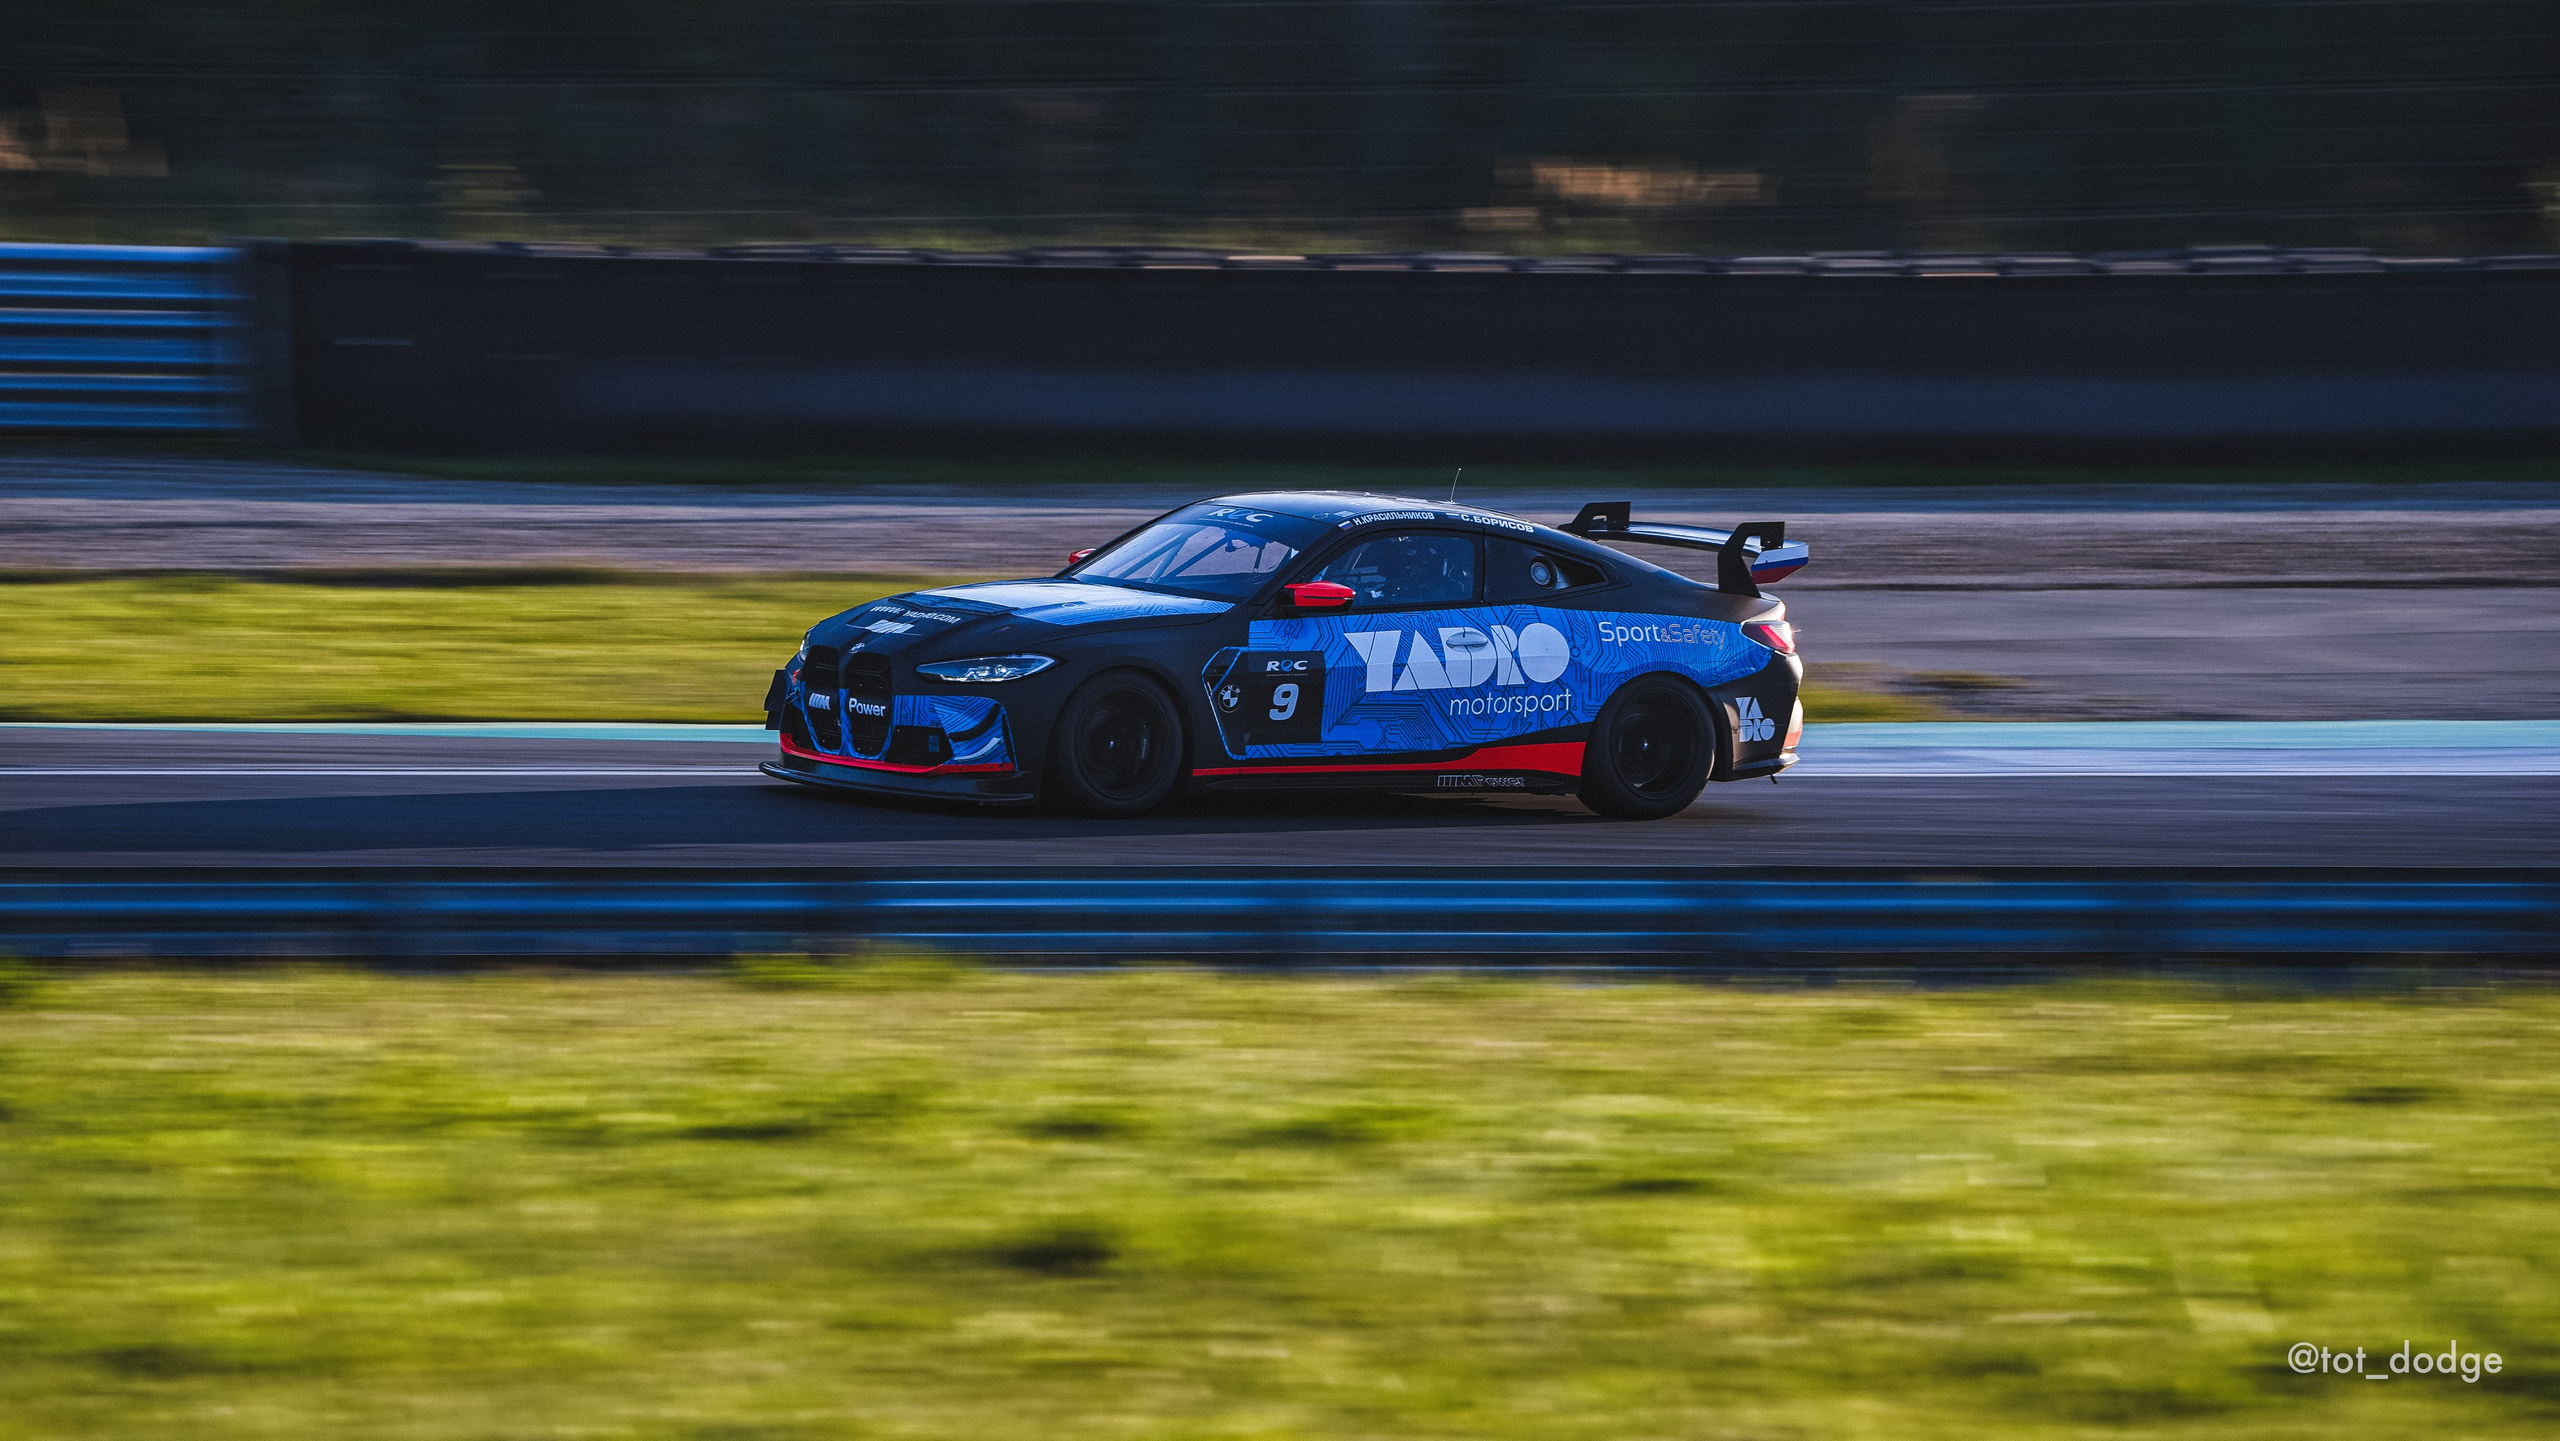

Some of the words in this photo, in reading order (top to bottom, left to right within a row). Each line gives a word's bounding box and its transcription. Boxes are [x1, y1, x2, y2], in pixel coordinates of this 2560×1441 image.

[1353, 511, 1435, 526] Н.КРАСИЛЬНИКОВ
[1460, 513, 1535, 533] С.БОРИСОВ
[1343, 622, 1571, 693] YADRO
[848, 697, 886, 717] Power
[1269, 683, 1300, 721] 9
[1450, 688, 1571, 718] motorsport
